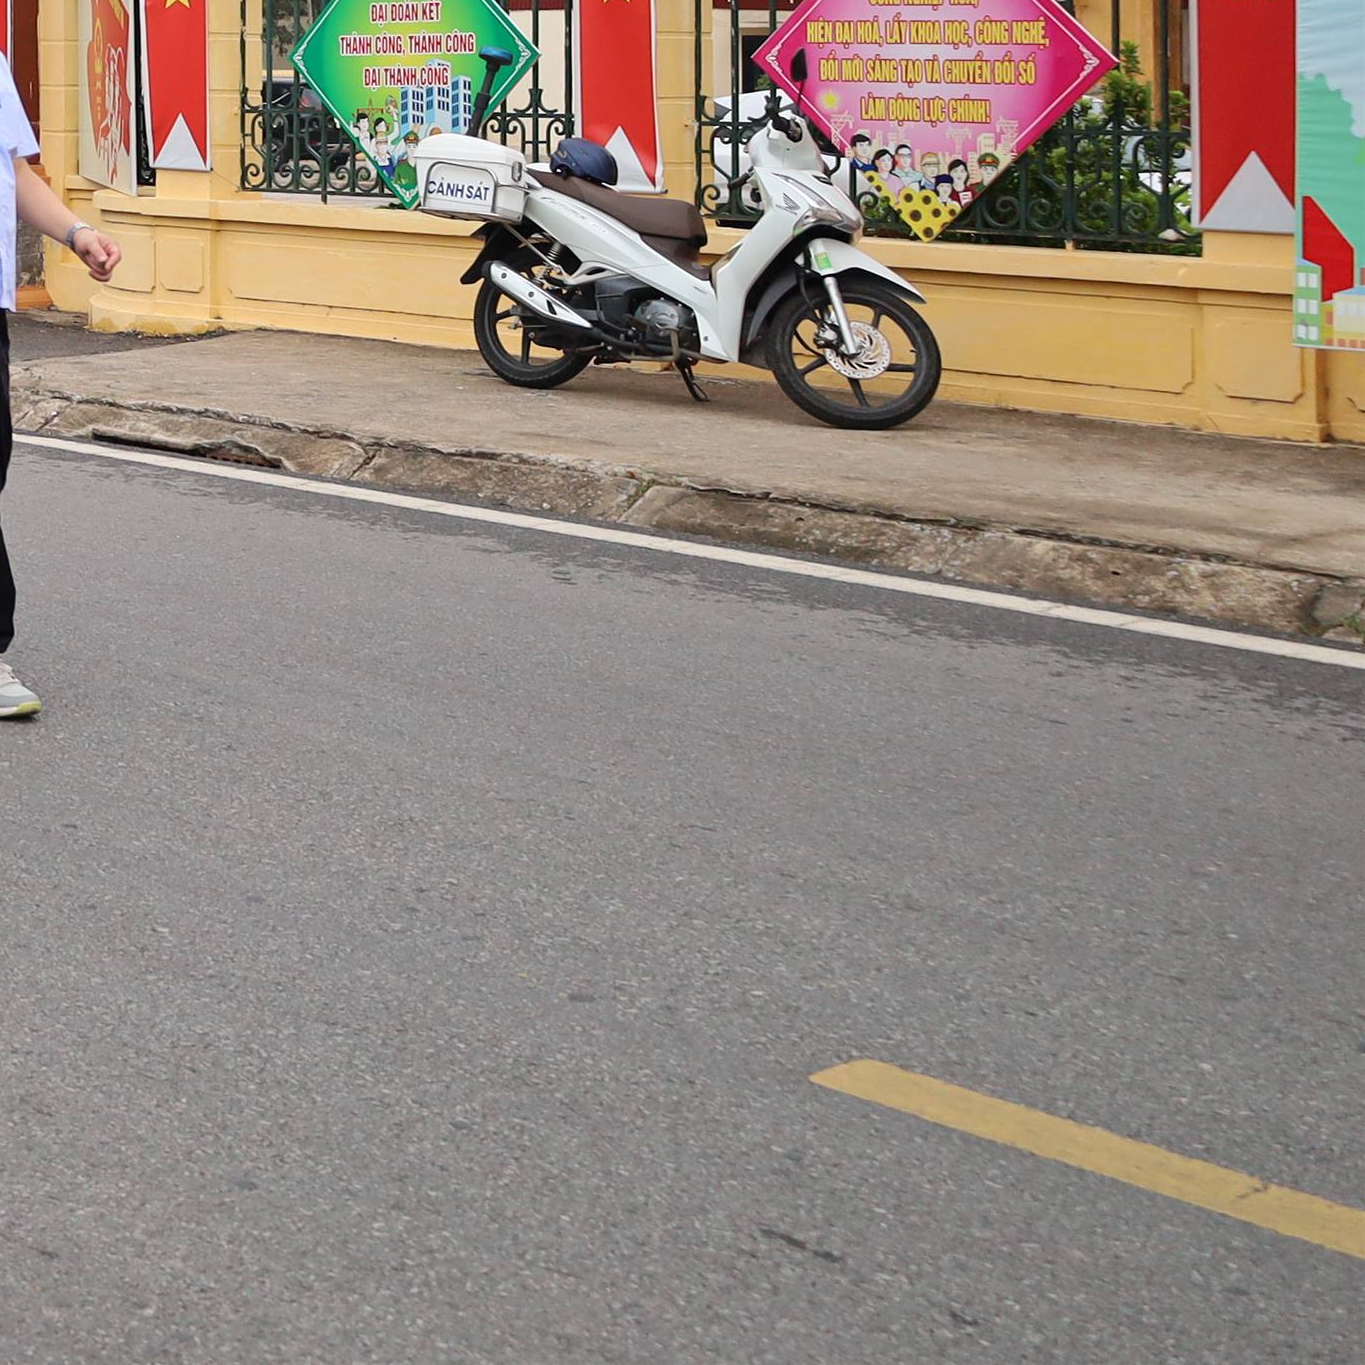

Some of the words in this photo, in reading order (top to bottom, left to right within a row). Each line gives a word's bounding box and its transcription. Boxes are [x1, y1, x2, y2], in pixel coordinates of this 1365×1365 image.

[371, 3, 387, 26] ĐẠI
[391, 0, 418, 21] ĐOÀN
[340, 32, 372, 54] THÀNH
[375, 33, 405, 55] CÔNG,
[408, 31, 442, 53] THÀNH
[445, 30, 475, 52] CÔNG
[806, 17, 832, 48] HIỆN
[835, 20, 854, 48] ĐẠI
[857, 16, 883, 46] HOÁ,
[886, 12, 908, 44] LẤY
[910, 20, 941, 44] KHOA
[944, 20, 972, 49] HỌC,
[975, 15, 1008, 44] CÔNG
[1012, 16, 1050, 49] NGHỆ,
[364, 68, 381, 91] ĐẠI
[384, 64, 417, 85] THÀNH
[420, 64, 449, 85] CÔNG
[820, 50, 839, 81] ĐỔI
[841, 54, 863, 81] MỚI
[866, 54, 898, 82] SÁNG
[901, 58, 922, 88] TẠO
[924, 54, 941, 83] VÀ
[943, 51, 990, 84] CHUYỂN
[994, 51, 1015, 84] ĐỔI
[1018, 52, 1036, 84] SỐ
[861, 92, 886, 120] LÀM
[888, 93, 921, 126] ĐỘNG
[923, 96, 946, 127] LỰC
[948, 94, 991, 123] CHÍNH!
[427, 177, 464, 198] CẢNH
[465, 181, 490, 201] SÁT
